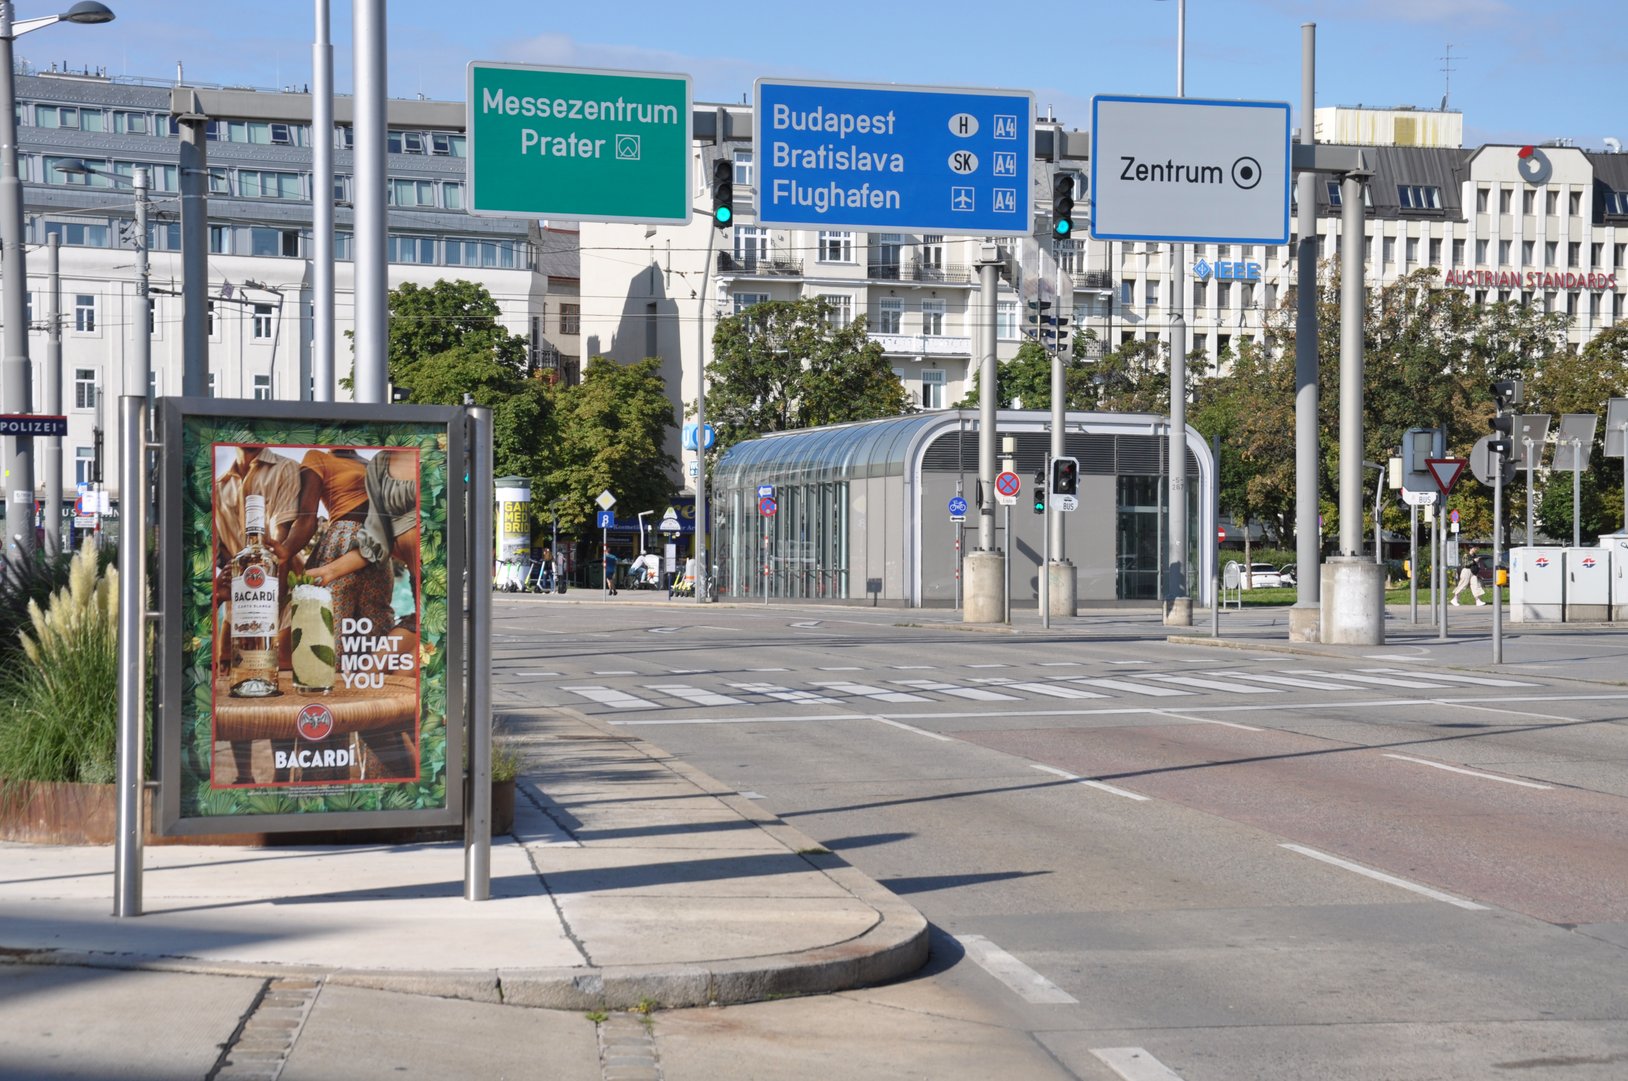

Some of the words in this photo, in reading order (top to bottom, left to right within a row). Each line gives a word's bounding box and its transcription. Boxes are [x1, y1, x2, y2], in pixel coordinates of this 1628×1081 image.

[483, 87, 678, 125] Messezentrum
[773, 103, 896, 139] Budapest
[958, 116, 969, 134] H
[995, 118, 1015, 137] A4
[521, 128, 606, 159] Prater
[773, 141, 904, 173] Bratislava
[954, 153, 972, 172] SK
[995, 155, 1015, 174] A4
[1120, 156, 1223, 184] Zentrum
[772, 179, 900, 213] Flughafen
[995, 191, 1015, 210] A4
[1214, 261, 1261, 280] IEEE
[1444, 269, 1522, 288] AUSTRIAN
[1525, 271, 1617, 289] STANDARDS
[0, 421, 57, 432] POLIZEI
[1063, 502, 1074, 511] BUS
[341, 617, 373, 635] DO
[341, 635, 403, 653] WHAT
[341, 653, 414, 671] MOVES
[341, 672, 385, 689] YOU
[275, 743, 356, 769] BACARDÍ
